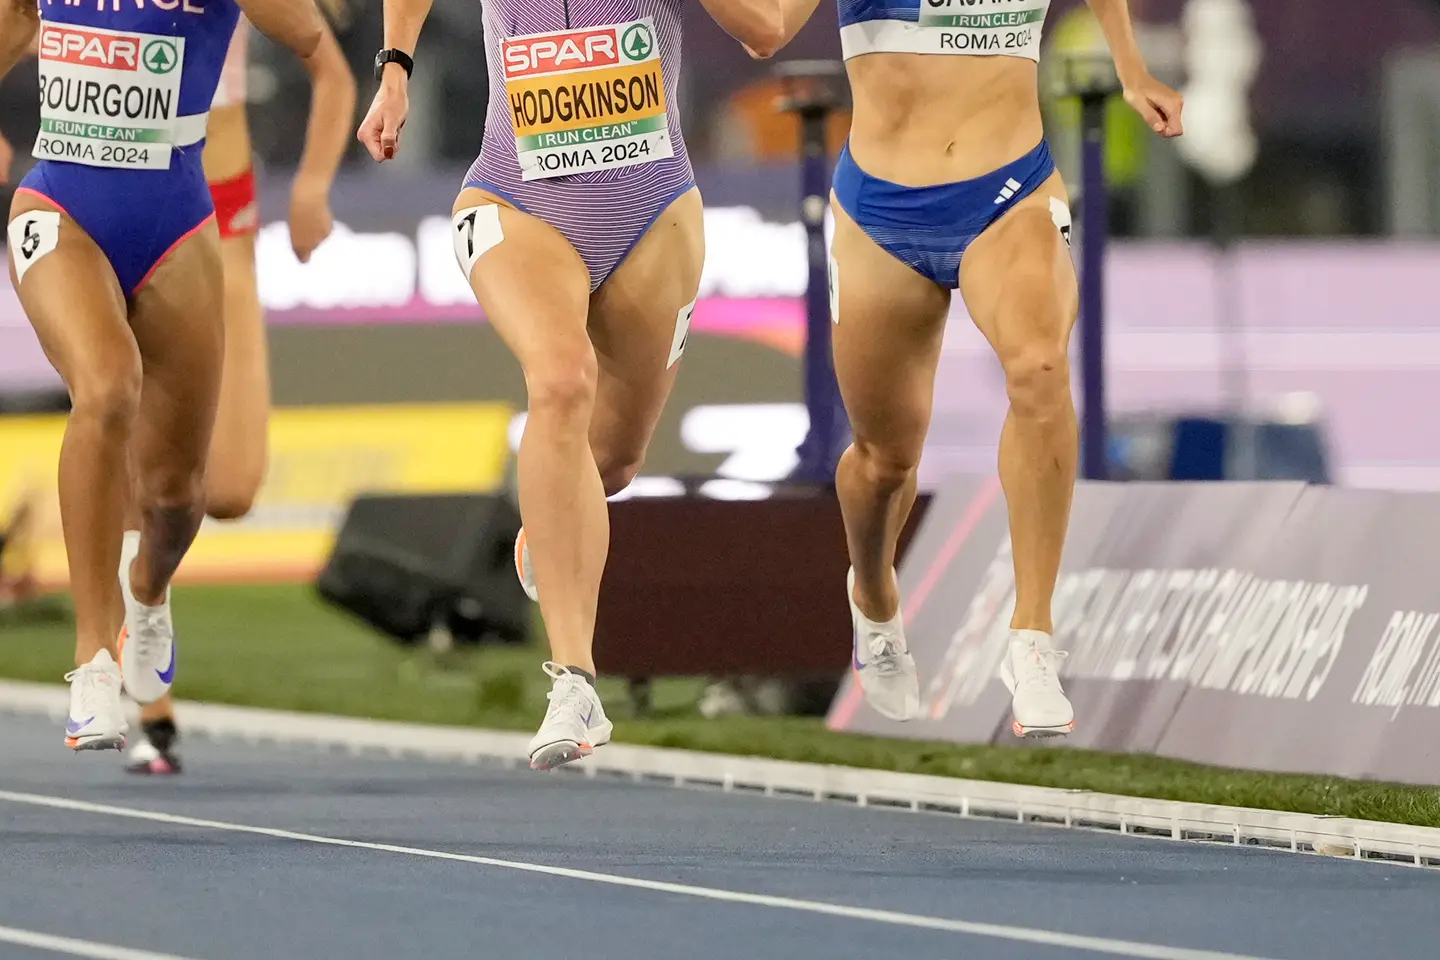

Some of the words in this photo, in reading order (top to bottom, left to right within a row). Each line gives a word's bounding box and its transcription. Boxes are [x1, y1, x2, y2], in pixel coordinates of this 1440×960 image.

[960, 15, 990, 27] RUN
[41, 31, 137, 67] SPAR
[506, 35, 615, 72] SPAR
[940, 33, 1001, 50] ROMA
[1005, 28, 1032, 49] 2024
[511, 72, 659, 128] HODGKINSON
[56, 121, 87, 135] RUN
[538, 135, 543, 147] I
[546, 130, 580, 146] RUN
[38, 139, 95, 160] ROMA
[101, 146, 149, 163] 2024
[536, 148, 597, 172] ROMA
[601, 139, 650, 163] 2024
[21, 220, 40, 259] 6
[457, 210, 478, 259] 7
